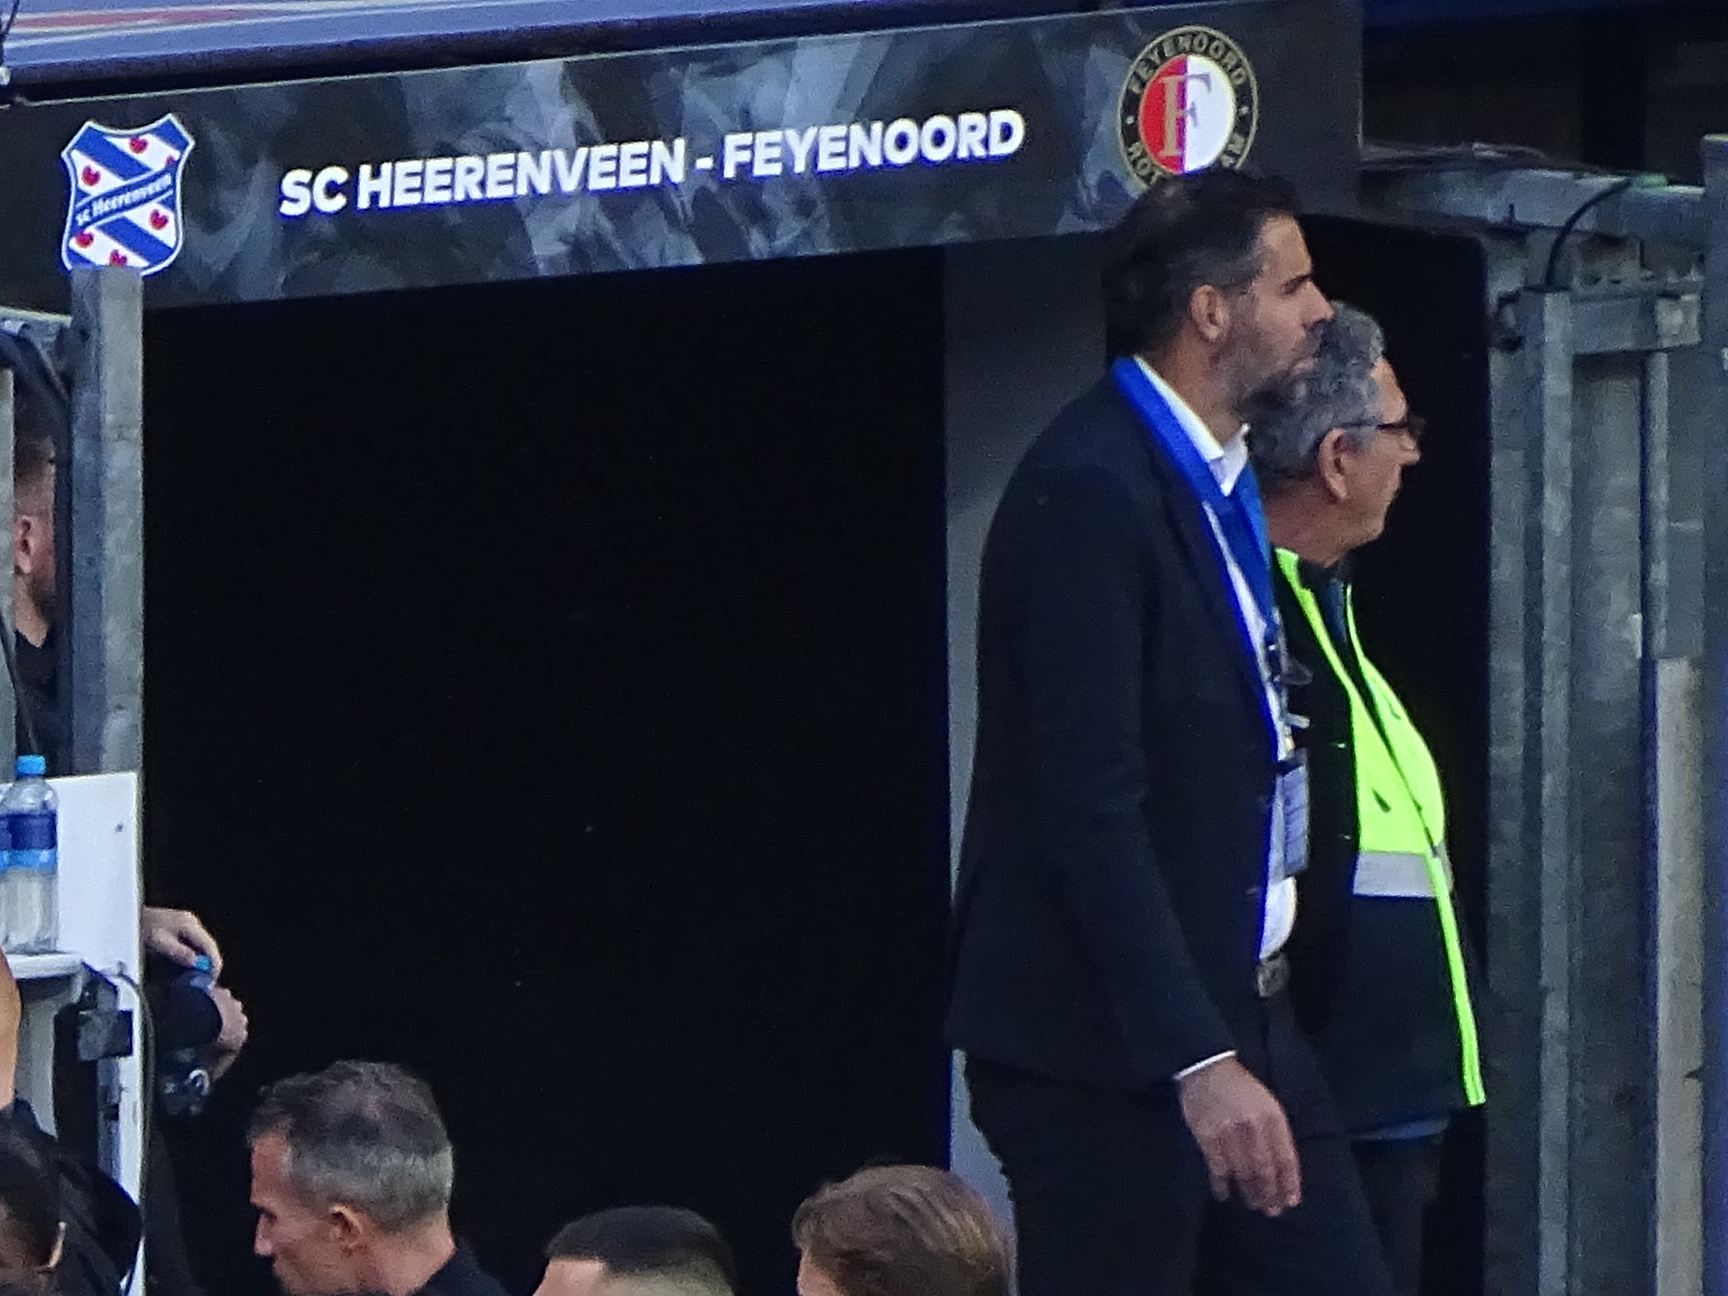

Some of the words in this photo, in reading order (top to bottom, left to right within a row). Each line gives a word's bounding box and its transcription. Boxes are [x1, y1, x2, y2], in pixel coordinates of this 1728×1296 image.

[279, 169, 347, 218] SC
[356, 137, 687, 211] HEERENVEEN
[722, 109, 1027, 179] FEYENOORD
